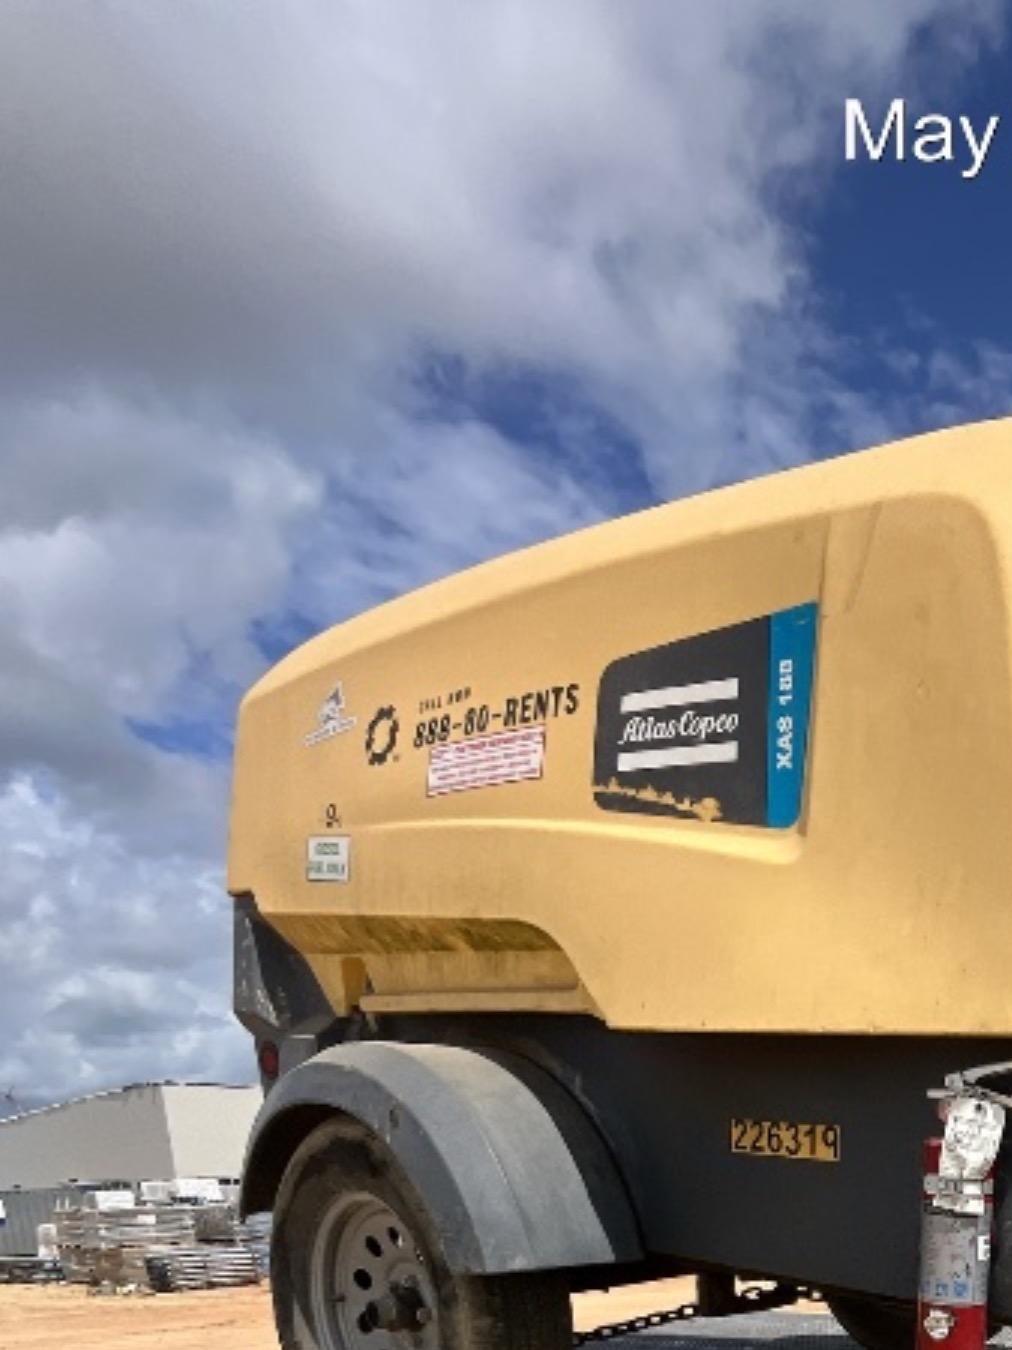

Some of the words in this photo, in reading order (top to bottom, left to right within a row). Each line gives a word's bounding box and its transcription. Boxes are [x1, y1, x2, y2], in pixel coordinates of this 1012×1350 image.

[617, 715, 678, 745] Atlas
[677, 709, 740, 741] Copco
[776, 715, 794, 770] XAS
[732, 1119, 839, 1159] 226319
